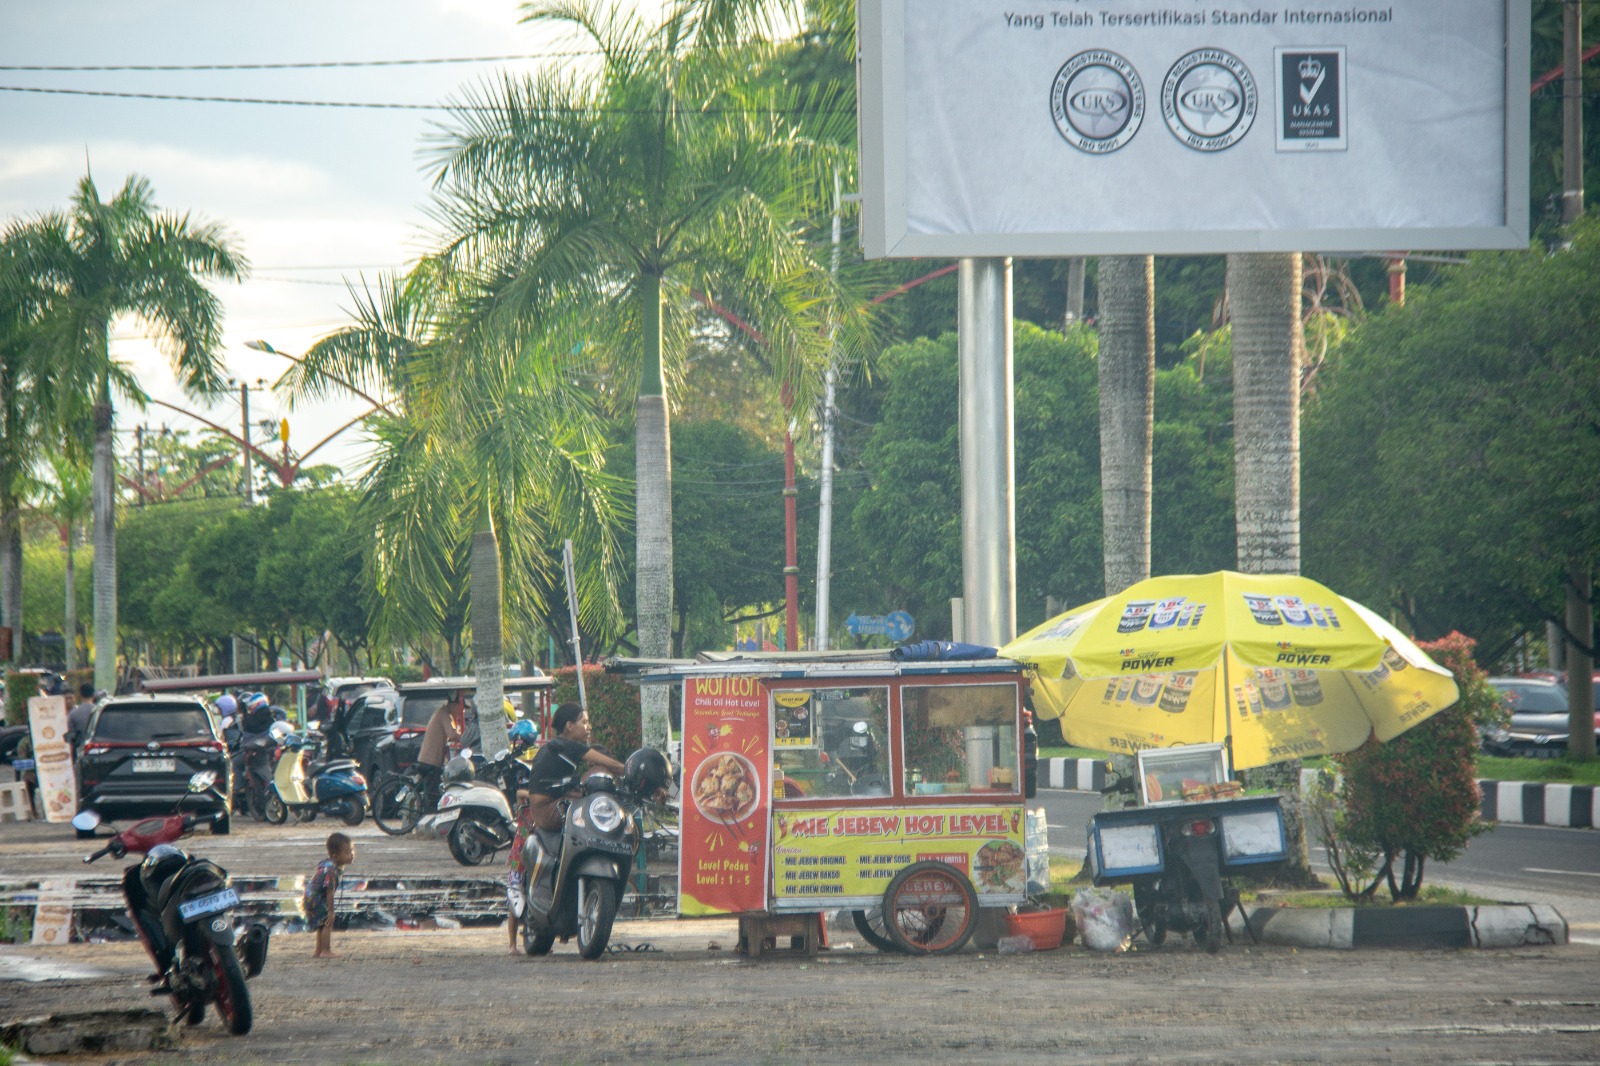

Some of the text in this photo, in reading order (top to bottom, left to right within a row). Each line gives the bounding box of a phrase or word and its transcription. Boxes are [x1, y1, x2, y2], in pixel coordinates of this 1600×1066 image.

[1004, 7, 1393, 30] Yang Telah Tersertifikasi Standar Internasional
[1292, 103, 1330, 117] UKAS
[1158, 600, 1184, 610] ABC
[1277, 599, 1303, 608] ABC
[1126, 607, 1150, 615] ABC
[1120, 648, 1135, 656] ABC
[1120, 657, 1176, 671] POWER
[1276, 653, 1332, 667] POWER
[695, 698, 760, 708] Chili Oil Hot Level
[791, 814, 1010, 838] MIE JEBEW HOT LEVEL
[860, 855, 872, 865] MIE
[698, 859, 749, 872] Level Pedas
[696, 872, 718, 885] Level
[785, 870, 797, 880] MIE
[860, 869, 872, 879] MIE
[785, 885, 797, 894] MIE
